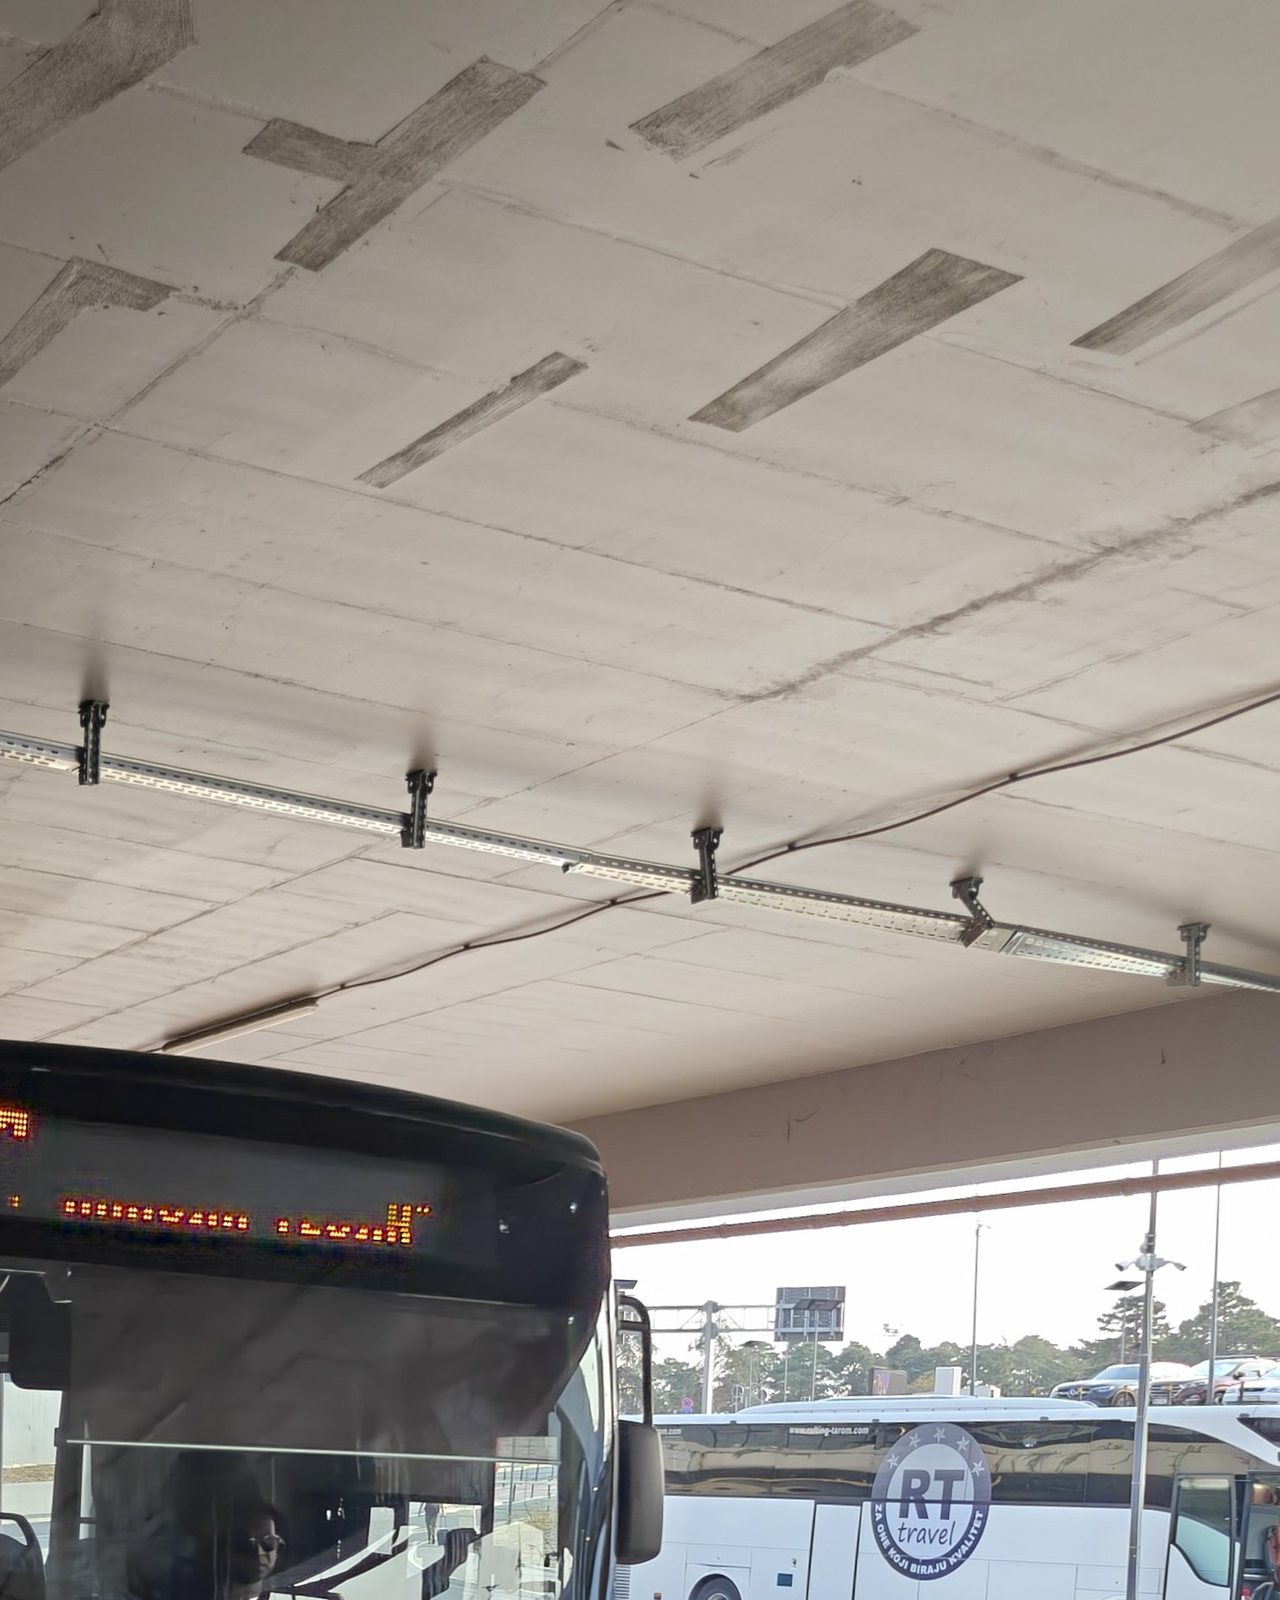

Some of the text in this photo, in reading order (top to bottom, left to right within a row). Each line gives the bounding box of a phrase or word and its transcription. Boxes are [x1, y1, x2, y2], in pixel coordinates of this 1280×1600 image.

[898, 1468, 966, 1520] RT
[874, 1503, 984, 1575] ZA ONE KOJI BIRAJU KVALITET
[897, 1520, 956, 1546] travel
